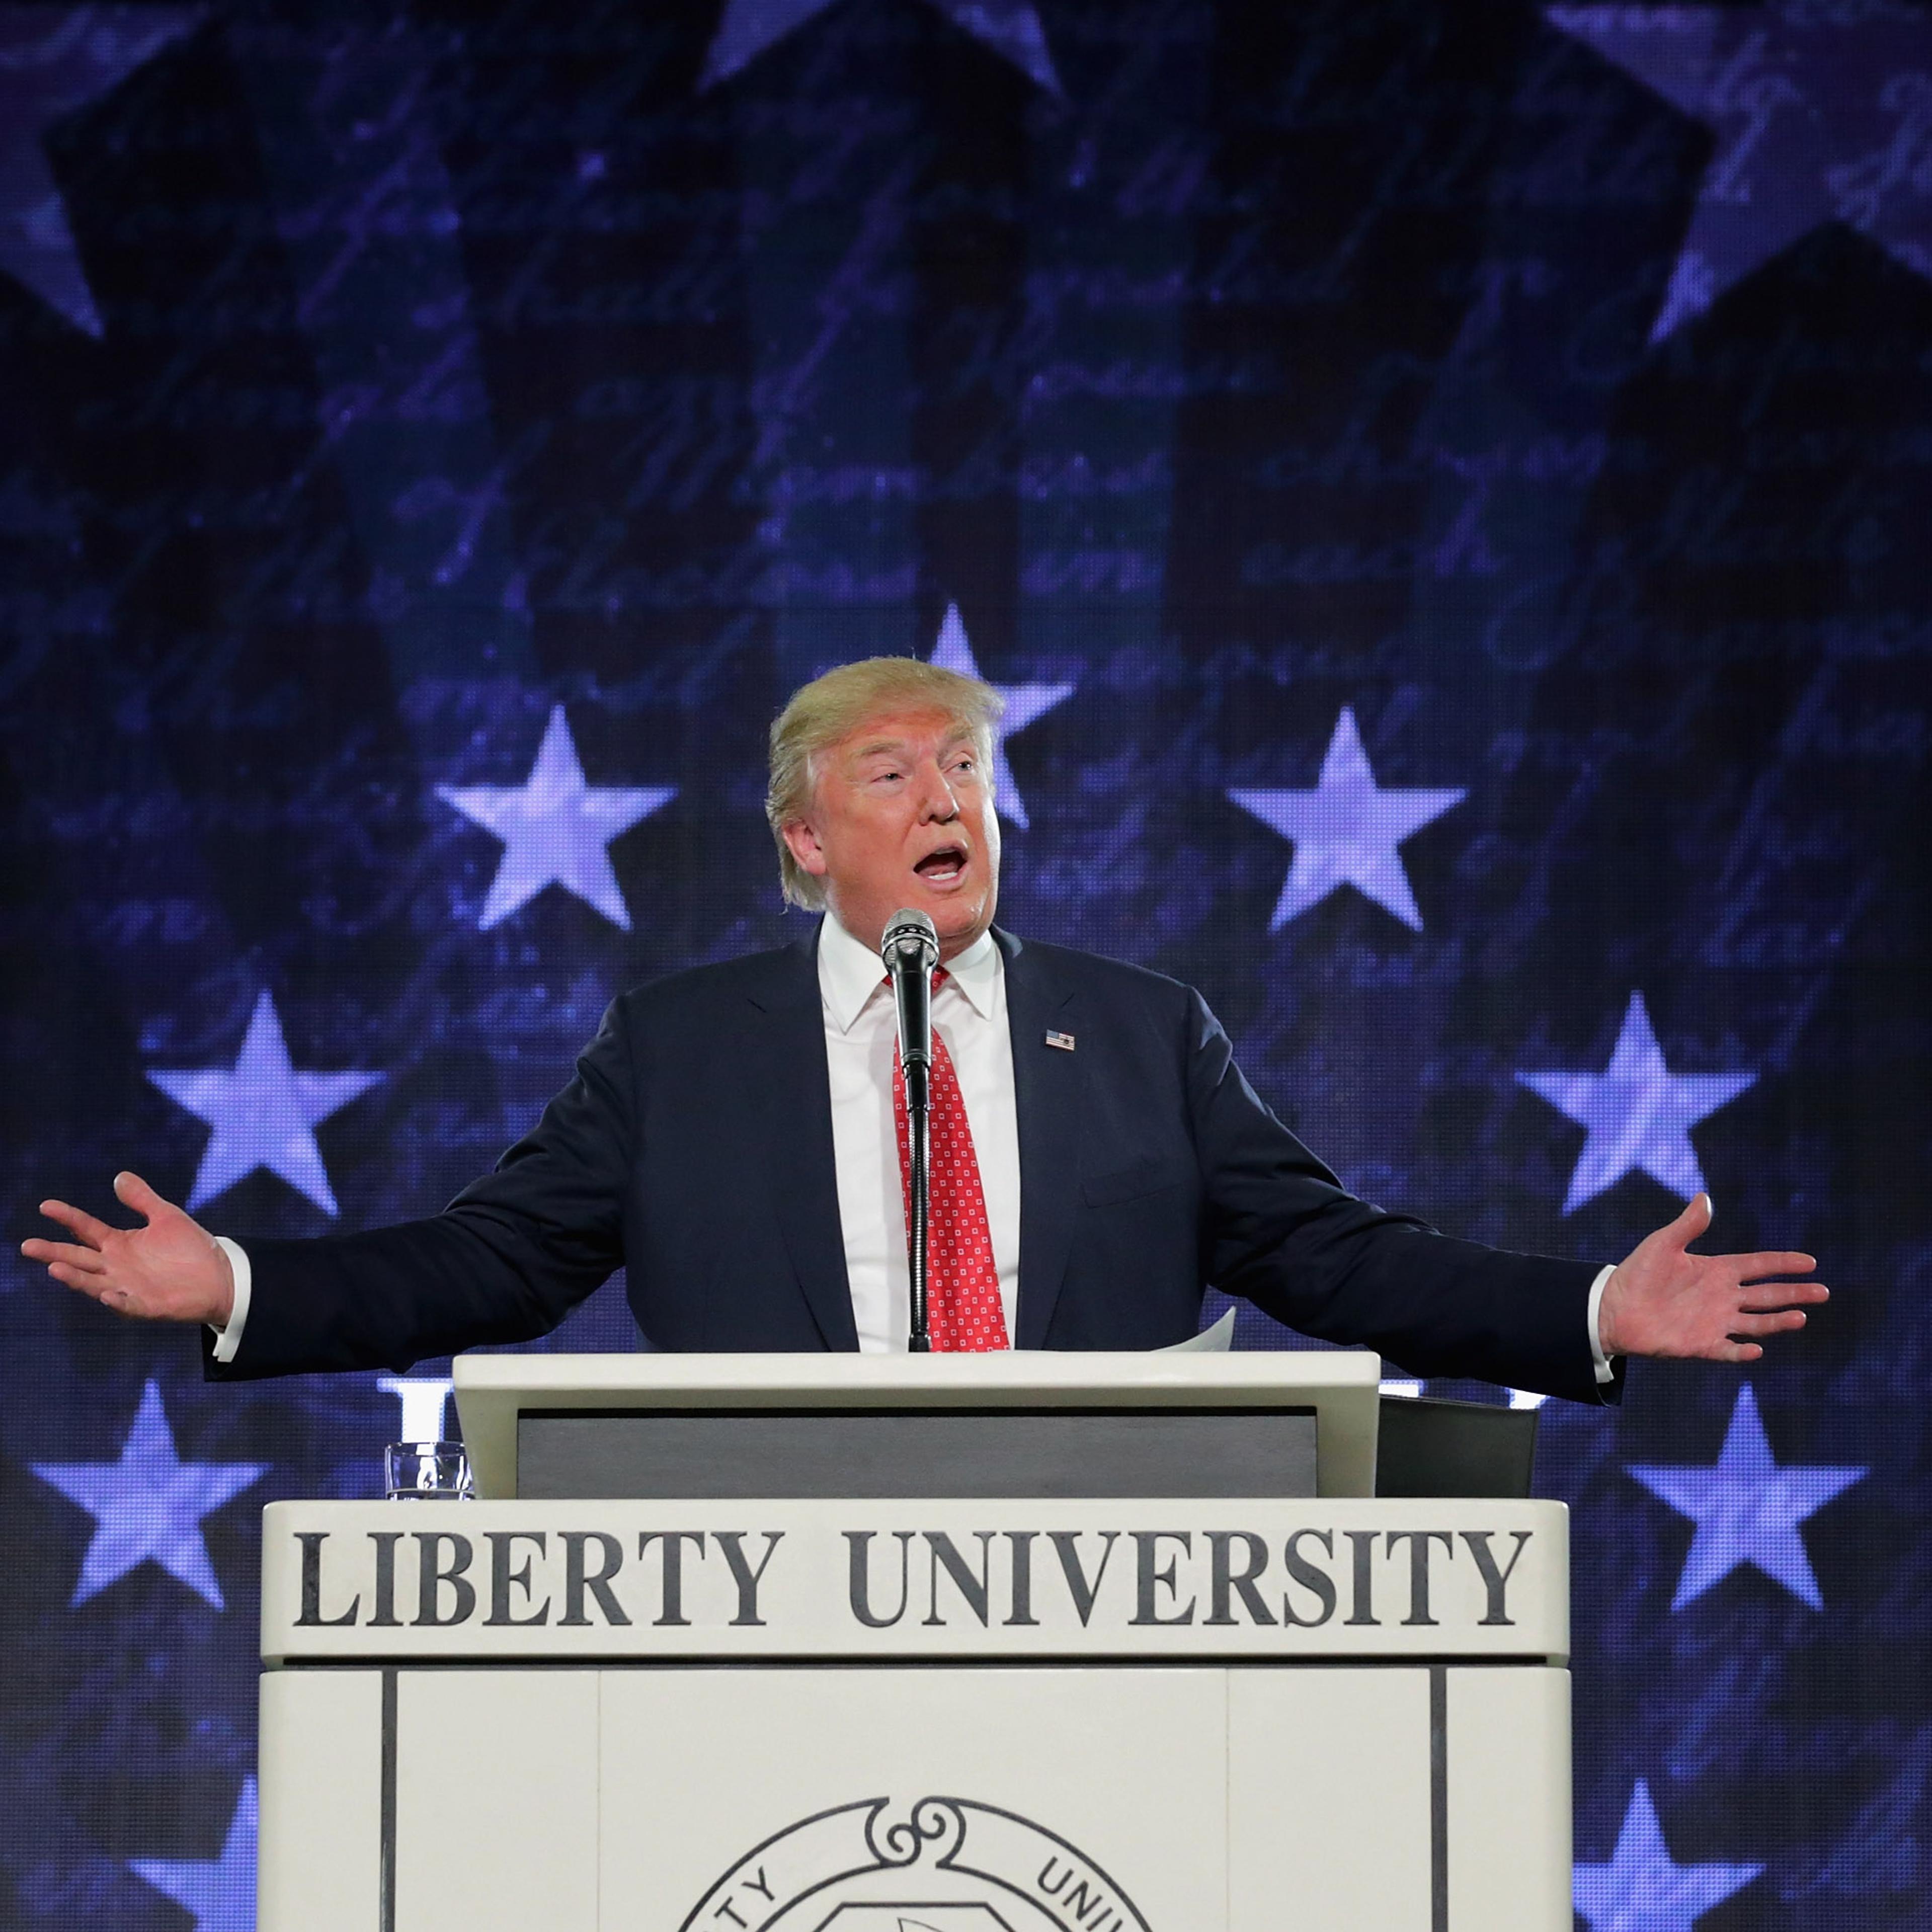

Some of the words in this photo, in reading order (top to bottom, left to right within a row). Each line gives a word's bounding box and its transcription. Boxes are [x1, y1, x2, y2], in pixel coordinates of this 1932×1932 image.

[292, 1531, 786, 1628] LIBERTY
[841, 1528, 1534, 1629] UNIVERSITY
[703, 1866, 775, 1932] TY
